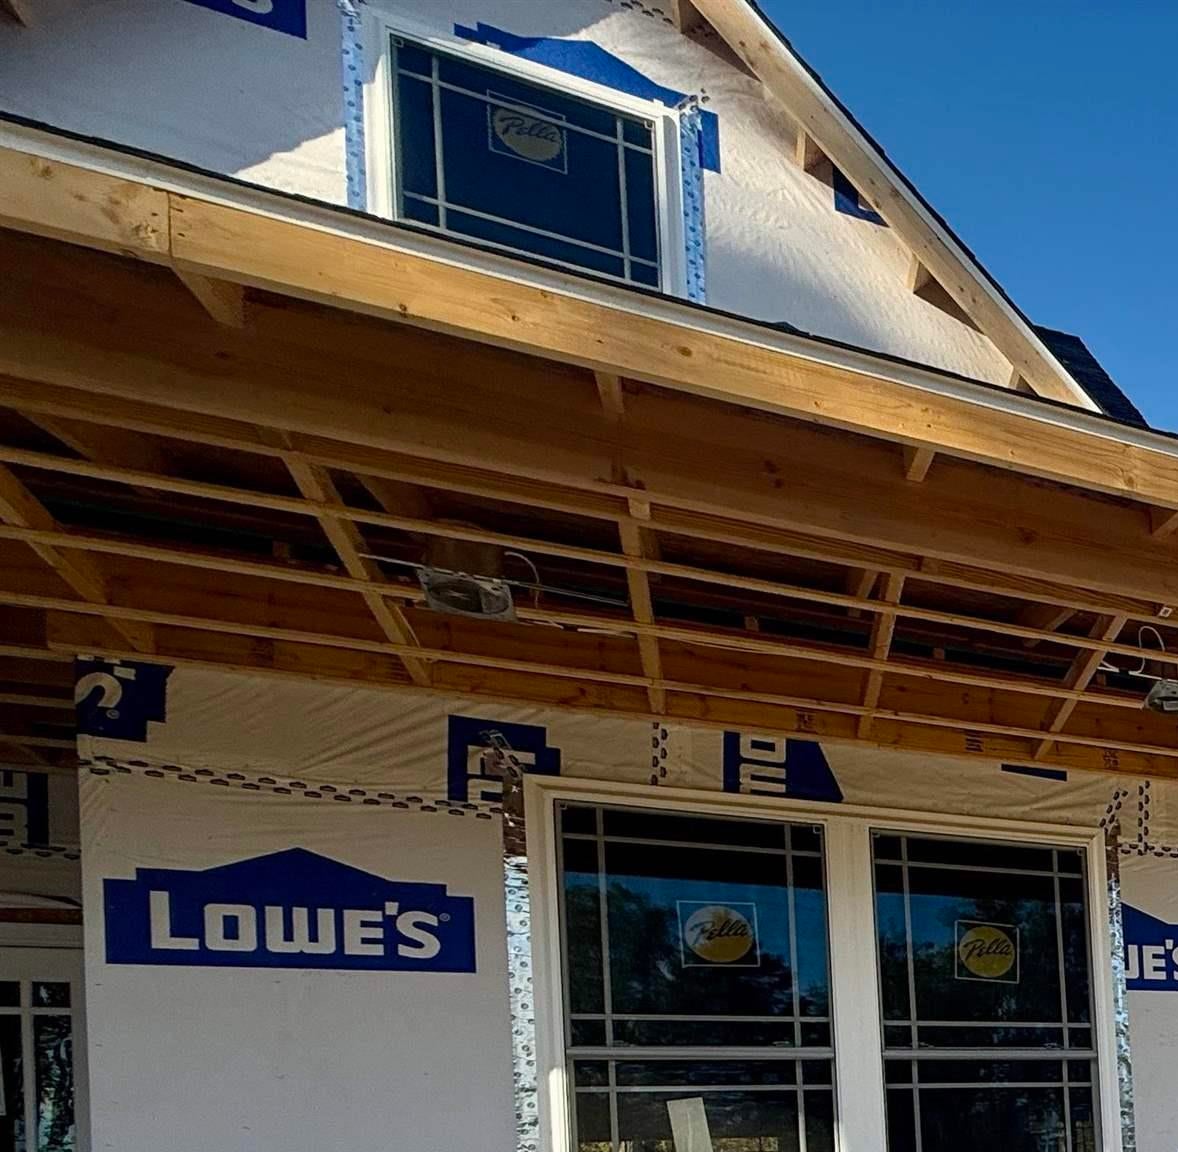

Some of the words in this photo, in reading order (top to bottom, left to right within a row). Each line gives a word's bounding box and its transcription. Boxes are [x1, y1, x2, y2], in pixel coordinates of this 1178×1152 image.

[150, 891, 441, 958] LOWE'S
[689, 919, 748, 945] Pella
[963, 939, 1012, 958] Pella
